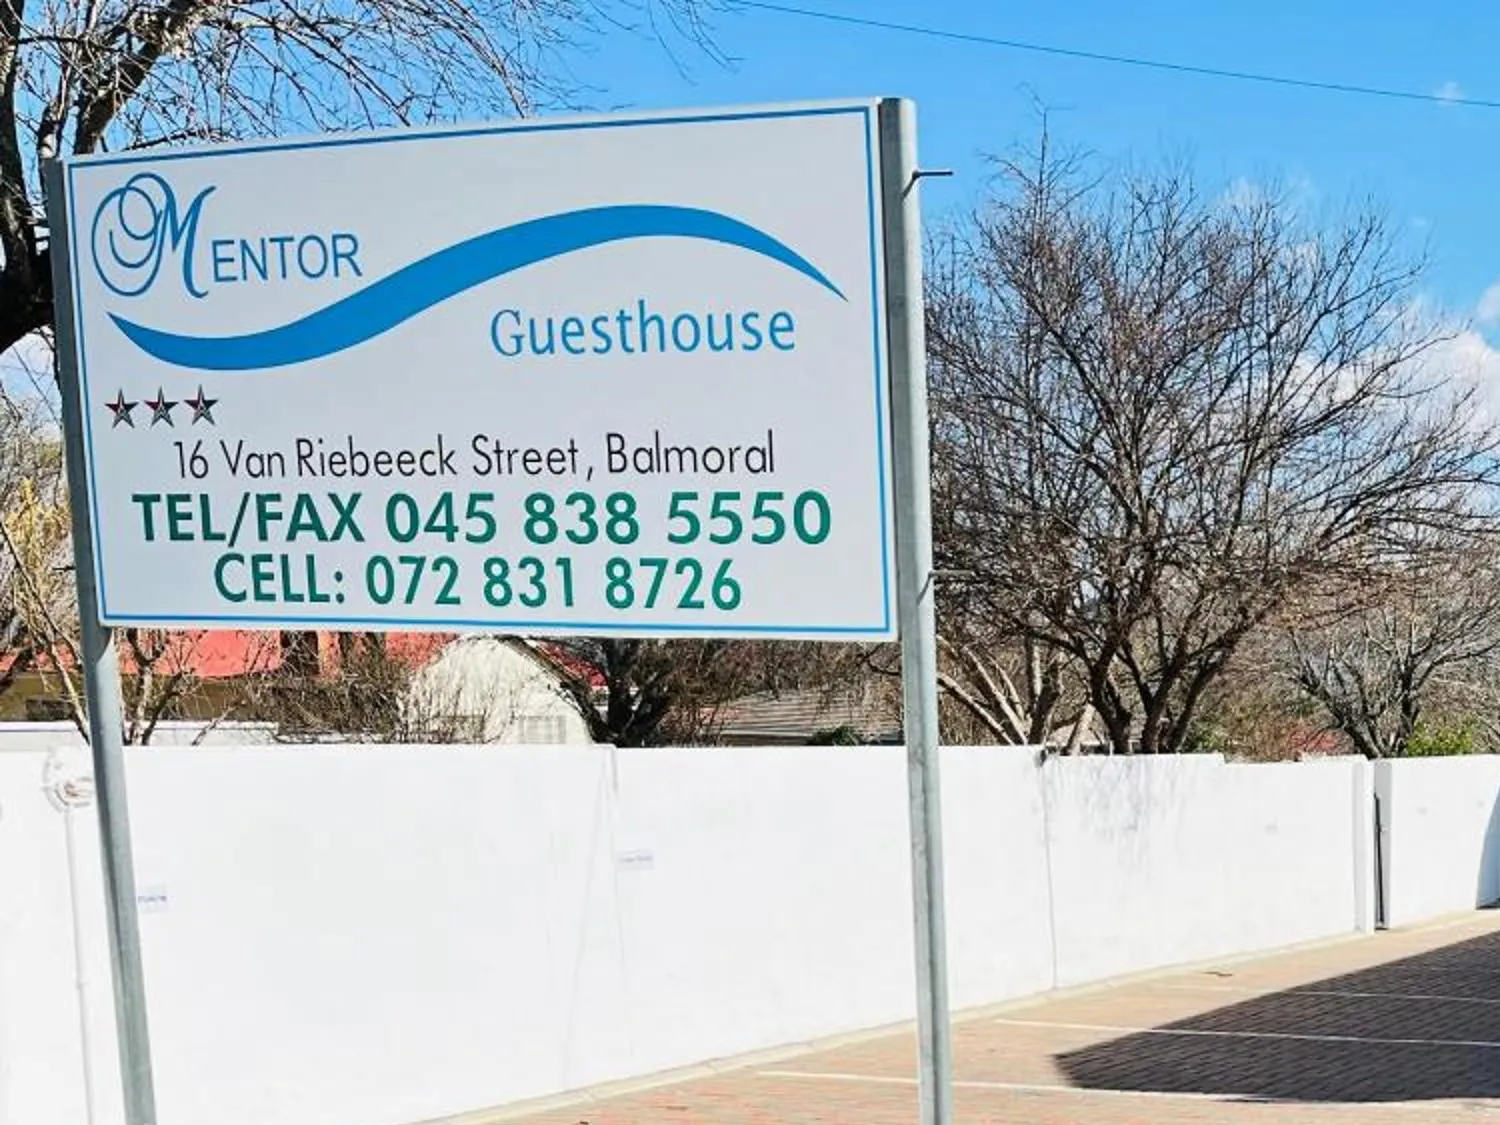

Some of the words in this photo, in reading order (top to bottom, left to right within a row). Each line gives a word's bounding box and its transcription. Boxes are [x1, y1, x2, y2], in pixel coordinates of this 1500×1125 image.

[490, 298, 796, 357] Guesthouse
[173, 439, 209, 479] 16
[219, 439, 286, 479] Van
[296, 434, 458, 478] Riebeeck
[471, 433, 593, 482] Street,
[606, 428, 775, 475] Balmoral
[132, 491, 366, 547] TEL/FAX
[385, 491, 497, 545] 045
[523, 491, 640, 545] 838
[667, 489, 832, 545] 5550
[213, 551, 345, 605] CELL:
[365, 554, 461, 606] 072
[483, 555, 574, 608] 831
[605, 556, 742, 611] 8726
